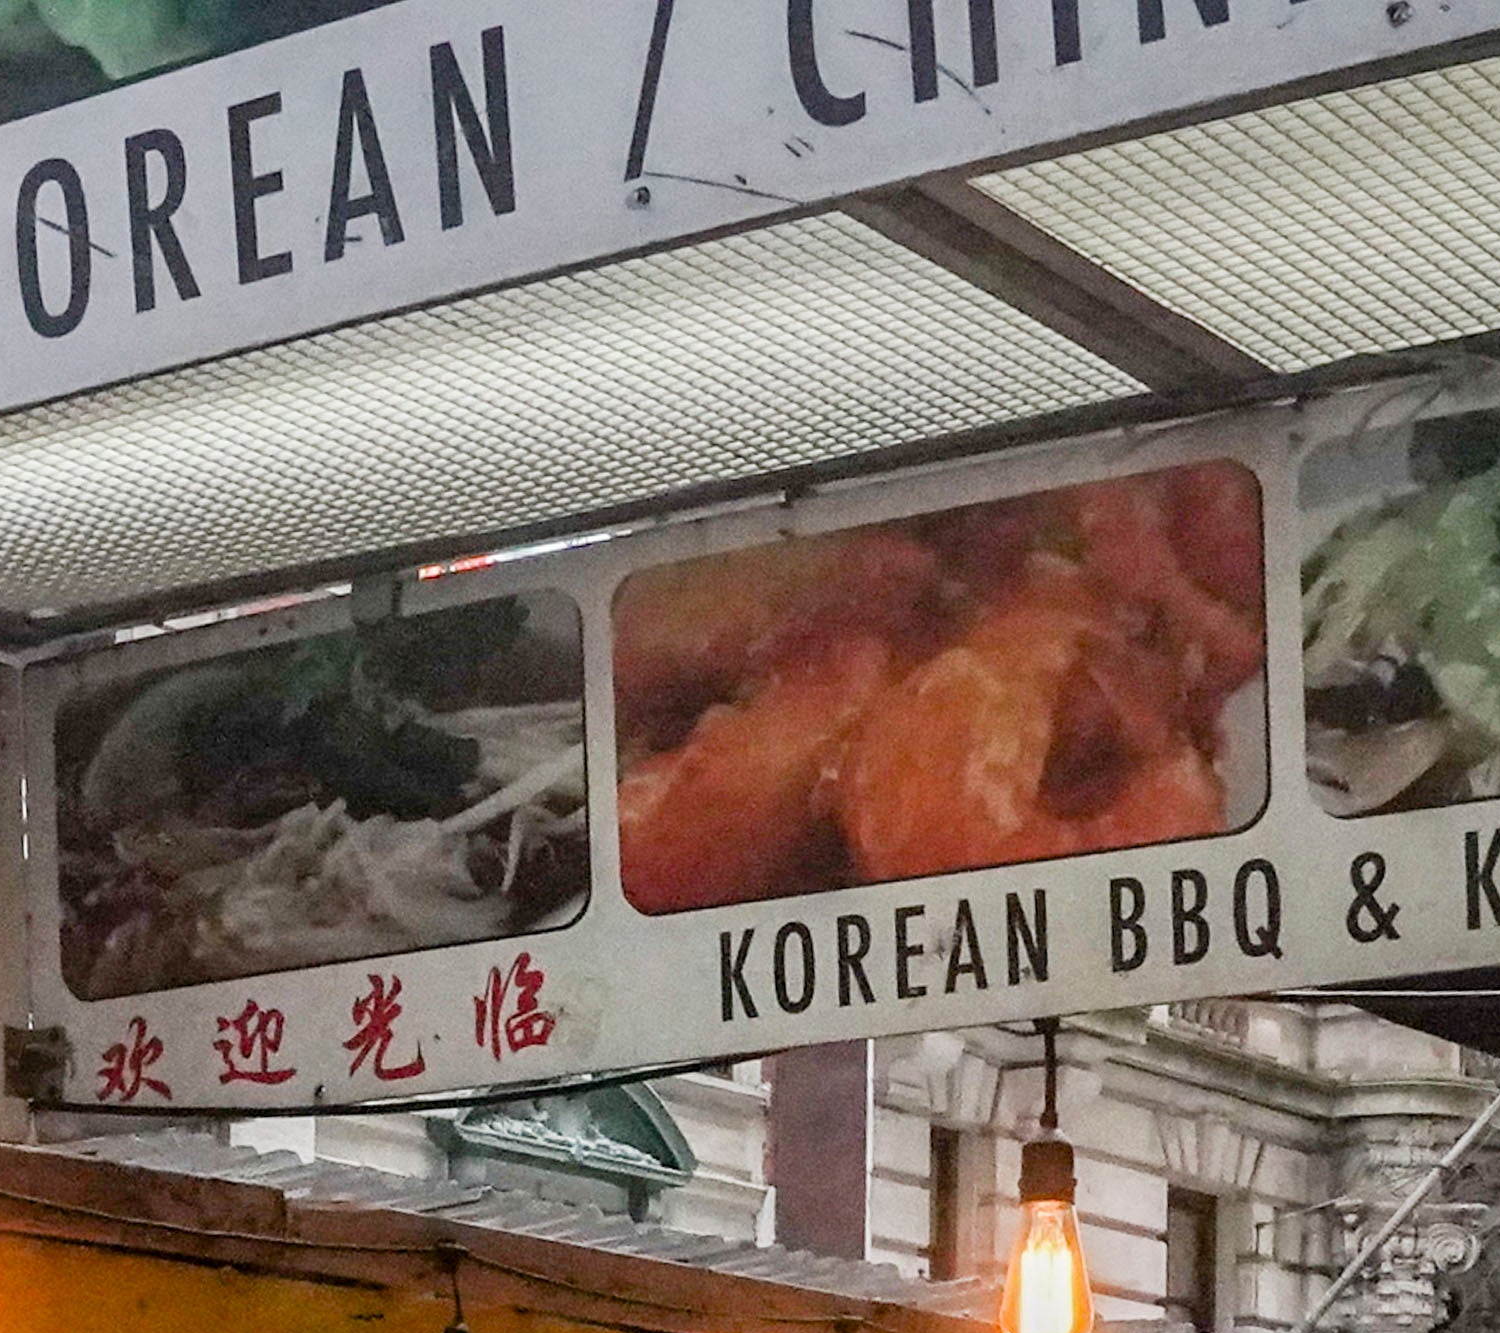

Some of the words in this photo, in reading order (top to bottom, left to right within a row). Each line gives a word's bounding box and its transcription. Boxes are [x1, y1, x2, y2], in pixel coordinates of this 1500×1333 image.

[718, 888, 1051, 1023] KOREAN
[1107, 857, 1284, 976] BBQ
[1345, 852, 1403, 946] &
[95, 952, 557, 1105] 欢迎光临
